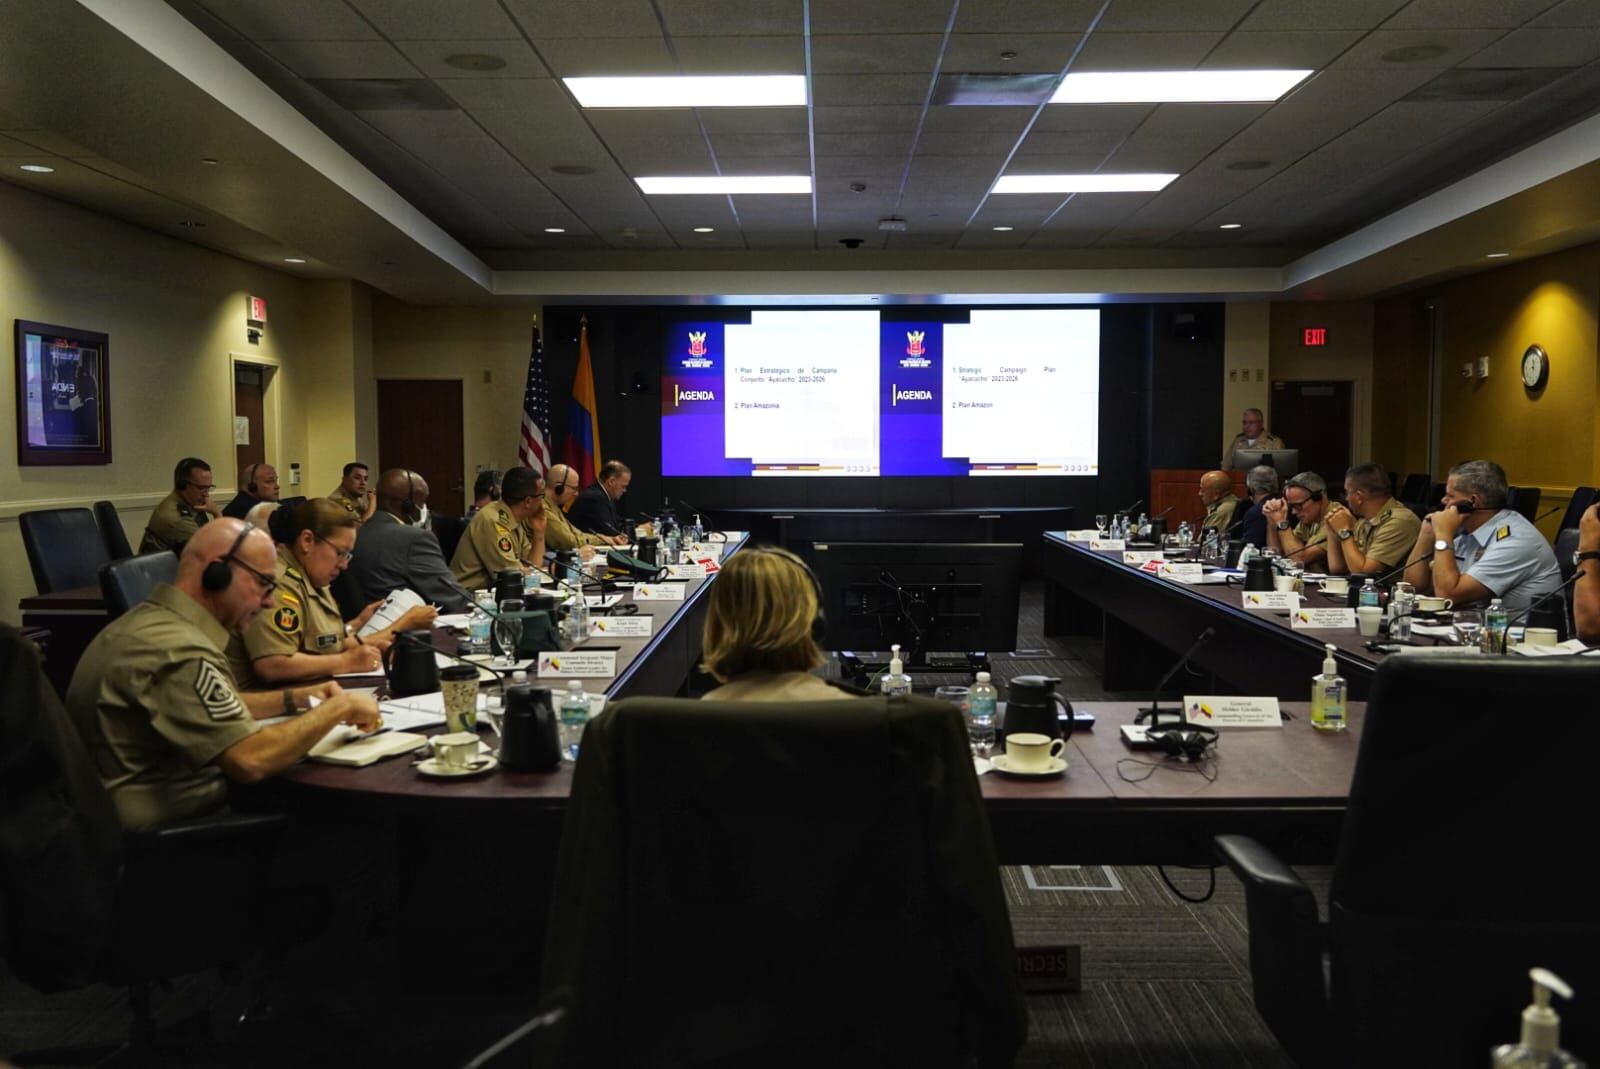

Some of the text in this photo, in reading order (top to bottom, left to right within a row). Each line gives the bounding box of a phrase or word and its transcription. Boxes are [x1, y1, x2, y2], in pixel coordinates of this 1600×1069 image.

[1305, 329, 1325, 345] EXIT
[999, 366, 1027, 375] Campaign
[798, 375, 825, 383] 2023-2026
[679, 391, 714, 400] AGENDA
[897, 391, 932, 400] AGENDA
